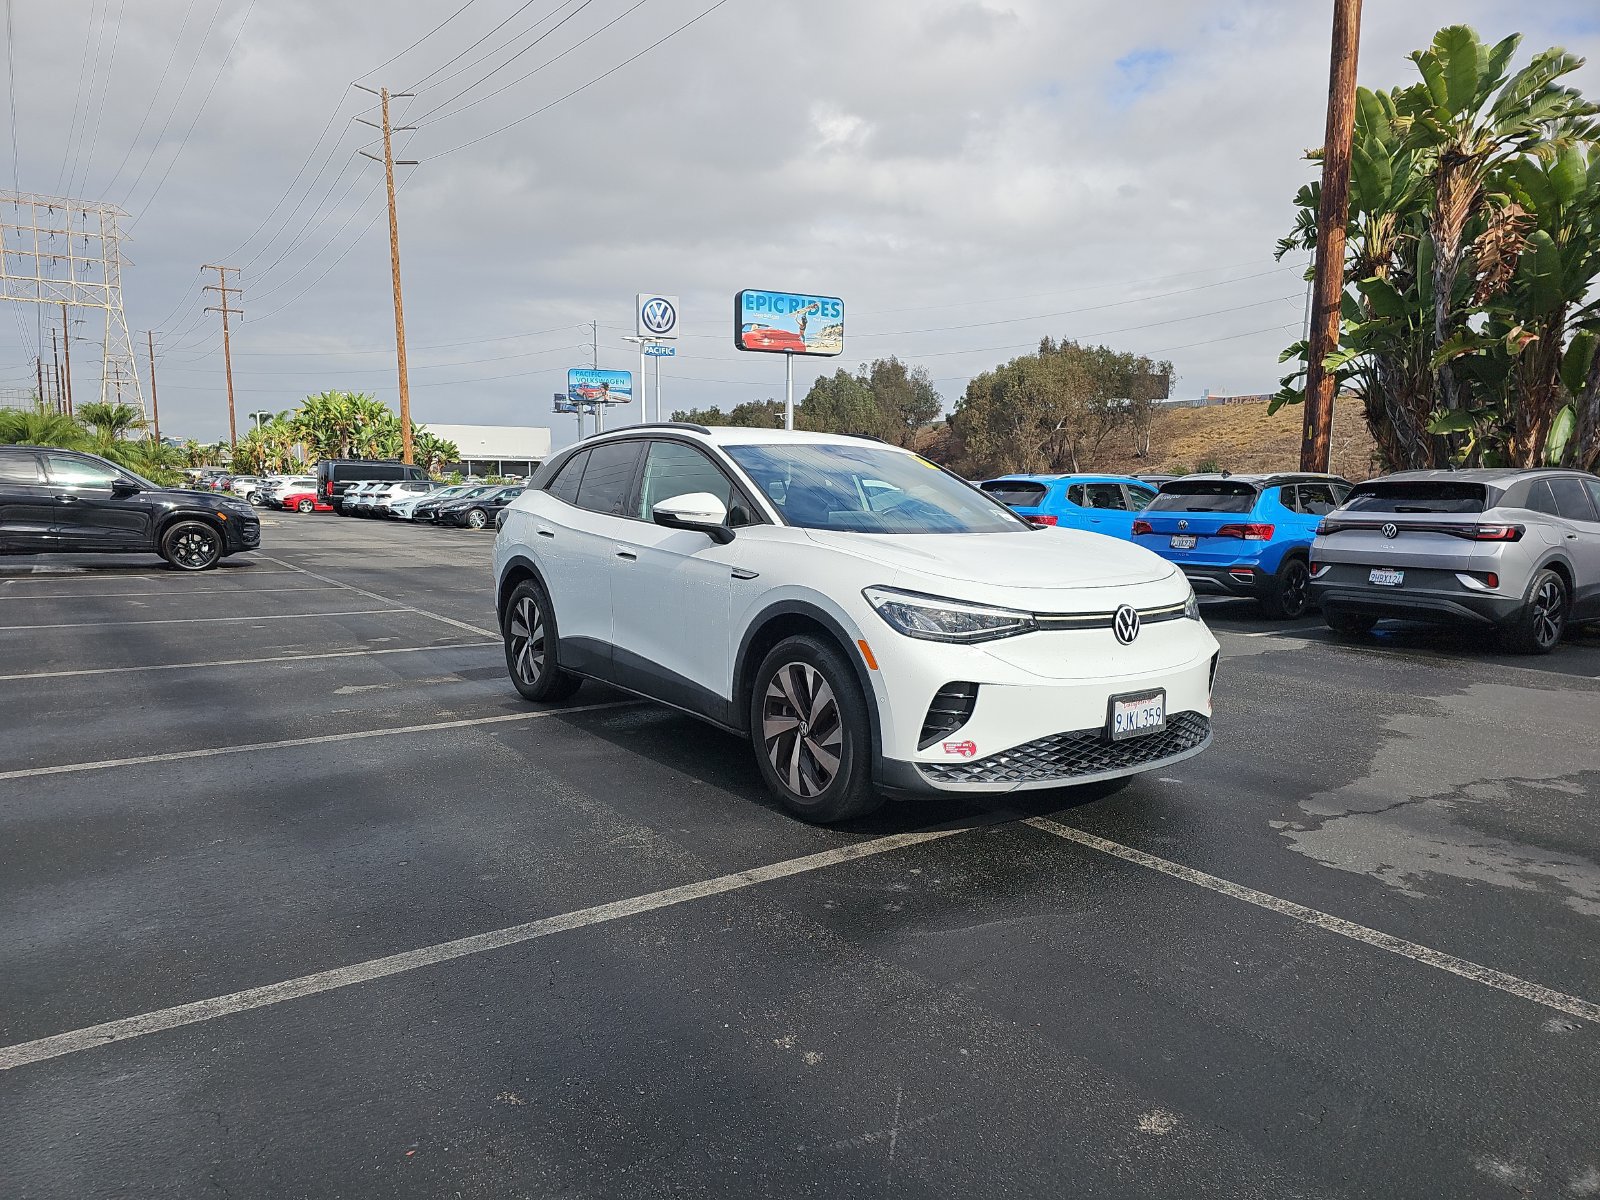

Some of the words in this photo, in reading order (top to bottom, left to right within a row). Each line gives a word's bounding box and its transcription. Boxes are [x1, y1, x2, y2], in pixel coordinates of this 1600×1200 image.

[745, 293, 785, 314] EPIC
[788, 297, 841, 318] RIDES
[644, 346, 674, 355] PACIFIC
[575, 370, 602, 378] PACIFIC
[575, 377, 625, 385] VOLKSWAGEN
[1117, 607, 1139, 642] VW
[1116, 706, 1161, 733] 9JKL359
